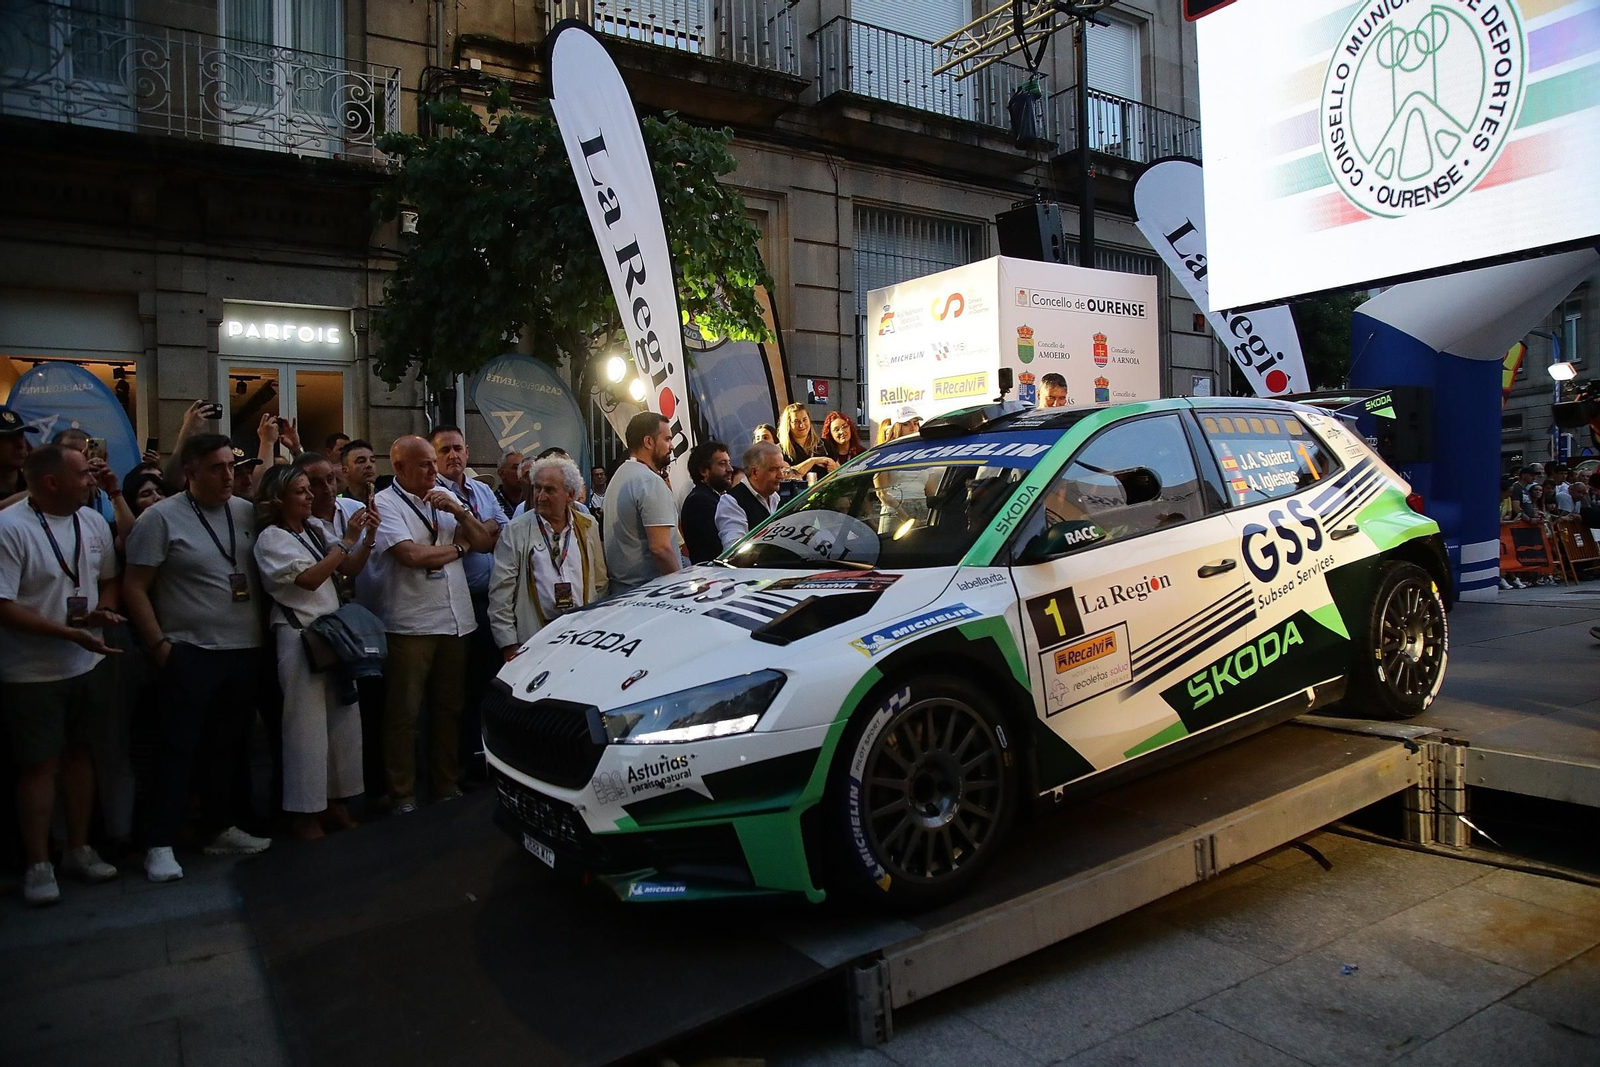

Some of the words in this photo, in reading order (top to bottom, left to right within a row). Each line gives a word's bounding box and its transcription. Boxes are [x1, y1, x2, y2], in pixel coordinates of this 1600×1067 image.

[1346, 0, 1404, 57] MUNIC
[1473, 5, 1512, 152] DEPORTES
[1329, 63, 1364, 187] CONSELLO
[577, 127, 622, 230] La
[1377, 165, 1463, 208] OURENSE
[1162, 217, 1208, 282] La
[1032, 294, 1072, 309] Concello
[1075, 299, 1085, 310] de
[1087, 299, 1145, 317] OURENSE
[228, 321, 340, 344] PARFOIS
[1038, 341, 1059, 349] Concello
[890, 351, 925, 364] MICHELIN
[1038, 351, 1070, 360] AMOEIRO
[1117, 357, 1140, 365] ARNOIA
[880, 387, 925, 402] Rallycar
[943, 378, 977, 395] Recalvi
[873, 443, 1052, 466] MICHELIN
[1240, 452, 1260, 471] J.A.
[1258, 449, 1295, 467] Suárez
[1297, 442, 1320, 480] 1
[1248, 474, 1262, 491] A.
[1263, 469, 1300, 491] Iglesias
[1064, 525, 1099, 545] RACC
[1242, 499, 1323, 583] GSS
[1257, 579, 1295, 610] Subsea
[1296, 554, 1335, 586] Services
[1044, 598, 1066, 637] 1
[1079, 594, 1109, 615] La
[891, 608, 974, 638] MICHELIN
[1067, 640, 1104, 666] Recalvi
[1073, 671, 1108, 691] recoletas
[1110, 662, 1129, 676] salud
[855, 745, 867, 771] PILOT
[864, 720, 881, 746] SPORT
[628, 755, 689, 784] Asturias
[661, 768, 692, 784] natural
[850, 786, 876, 867] MICHELIN
